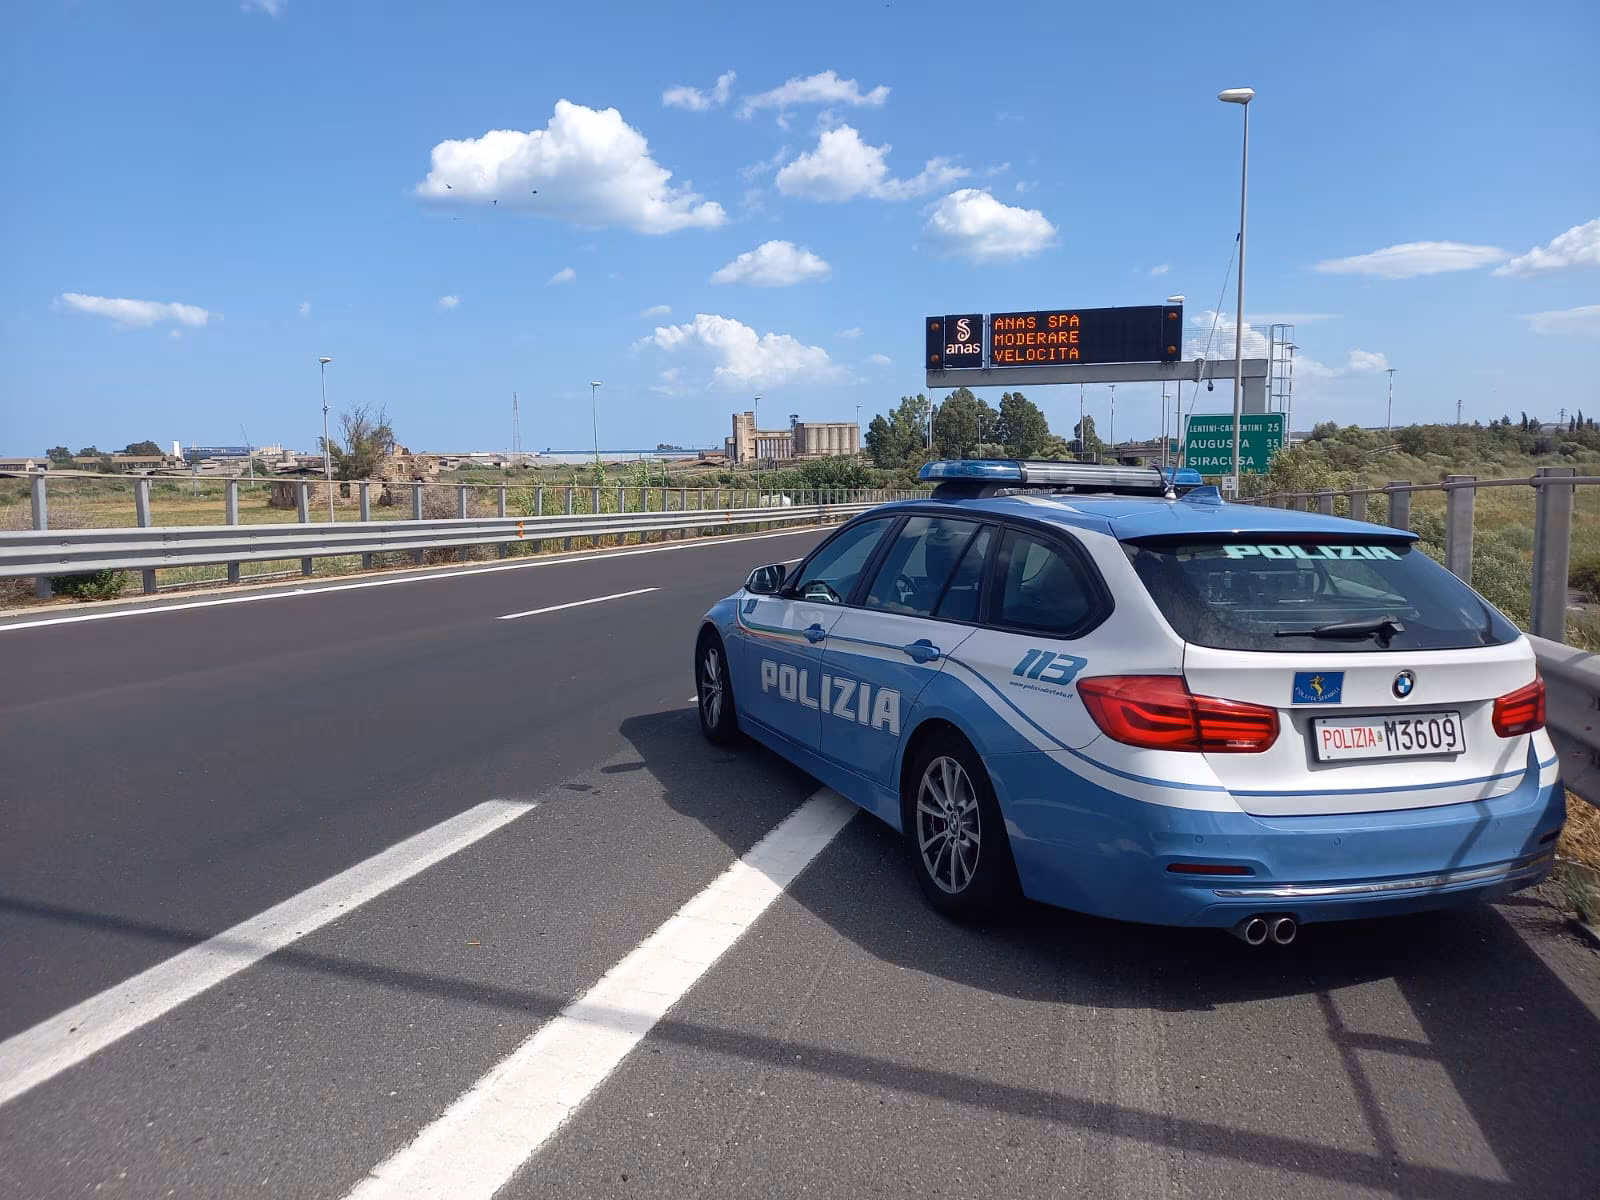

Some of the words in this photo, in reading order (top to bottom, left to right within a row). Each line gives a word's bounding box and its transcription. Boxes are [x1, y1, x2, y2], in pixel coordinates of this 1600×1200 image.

[994, 317, 1036, 330] ANAS
[1048, 314, 1079, 328] SPA
[994, 331, 1079, 346] MODERARE
[946, 342, 980, 354] anas
[994, 347, 1079, 361] VELOCITA
[1190, 424, 1262, 432] LENTINI-CARENTINI
[1267, 423, 1279, 432] 25
[1190, 439, 1250, 448] AUGUSA
[1266, 438, 1279, 448] 35
[1222, 545, 1402, 561] POLIZIA
[1013, 648, 1088, 686] 113
[760, 658, 901, 737] POLIZIA
[1322, 727, 1376, 750] POLIZIA
[1384, 718, 1457, 752] M3609
